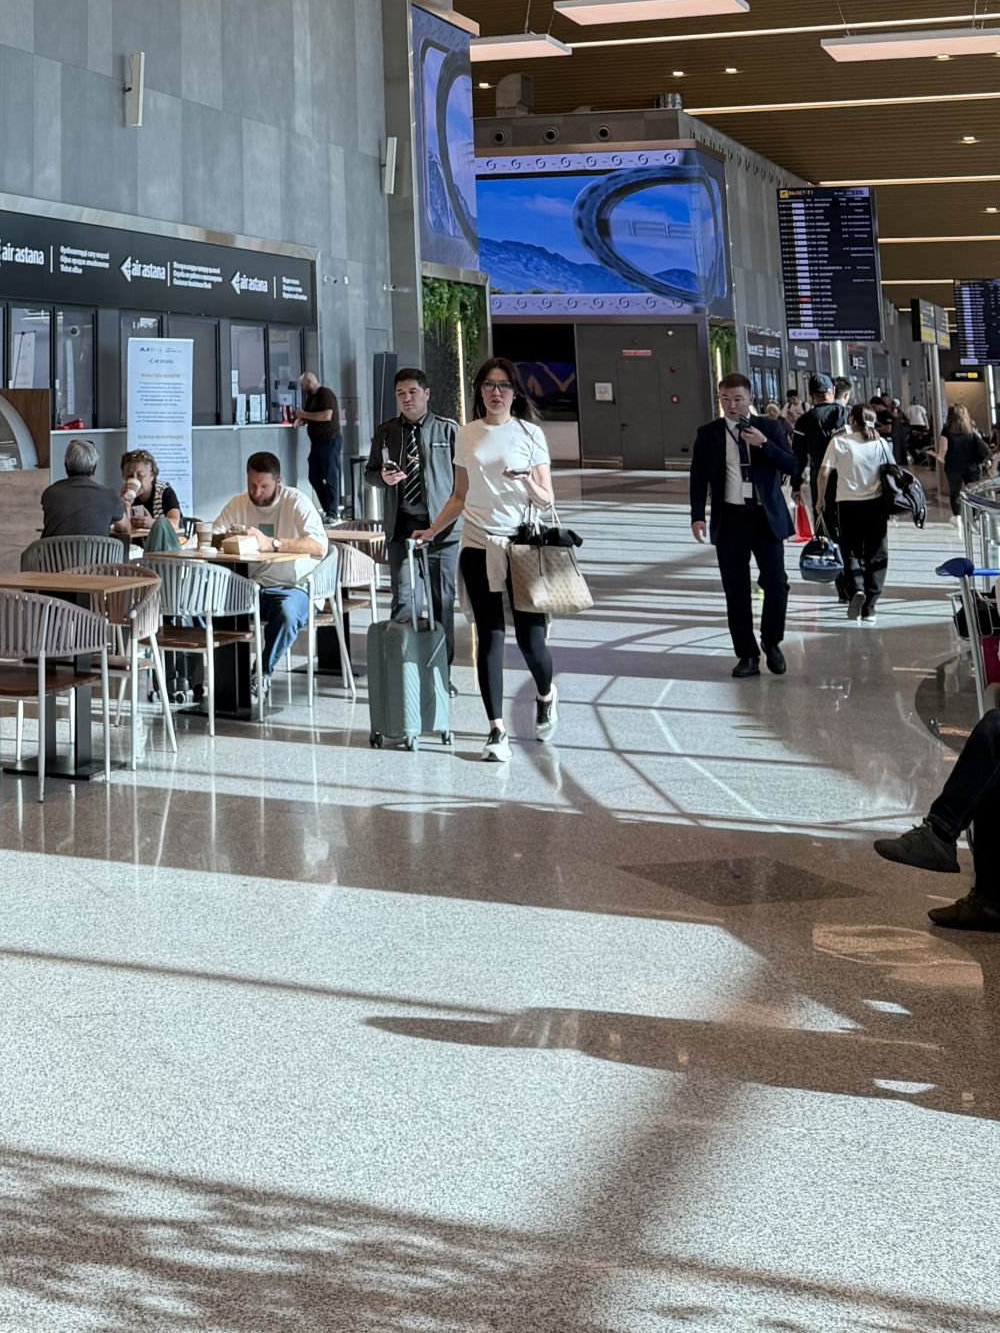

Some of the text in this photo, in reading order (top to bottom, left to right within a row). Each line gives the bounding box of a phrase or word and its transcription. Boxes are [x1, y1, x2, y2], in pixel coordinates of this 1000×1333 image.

[1, 242, 14, 262] air
[14, 246, 45, 266] astana
[131, 259, 142, 277] air
[142, 263, 166, 280] astana
[240, 274, 248, 290] air
[248, 277, 268, 293] astana
